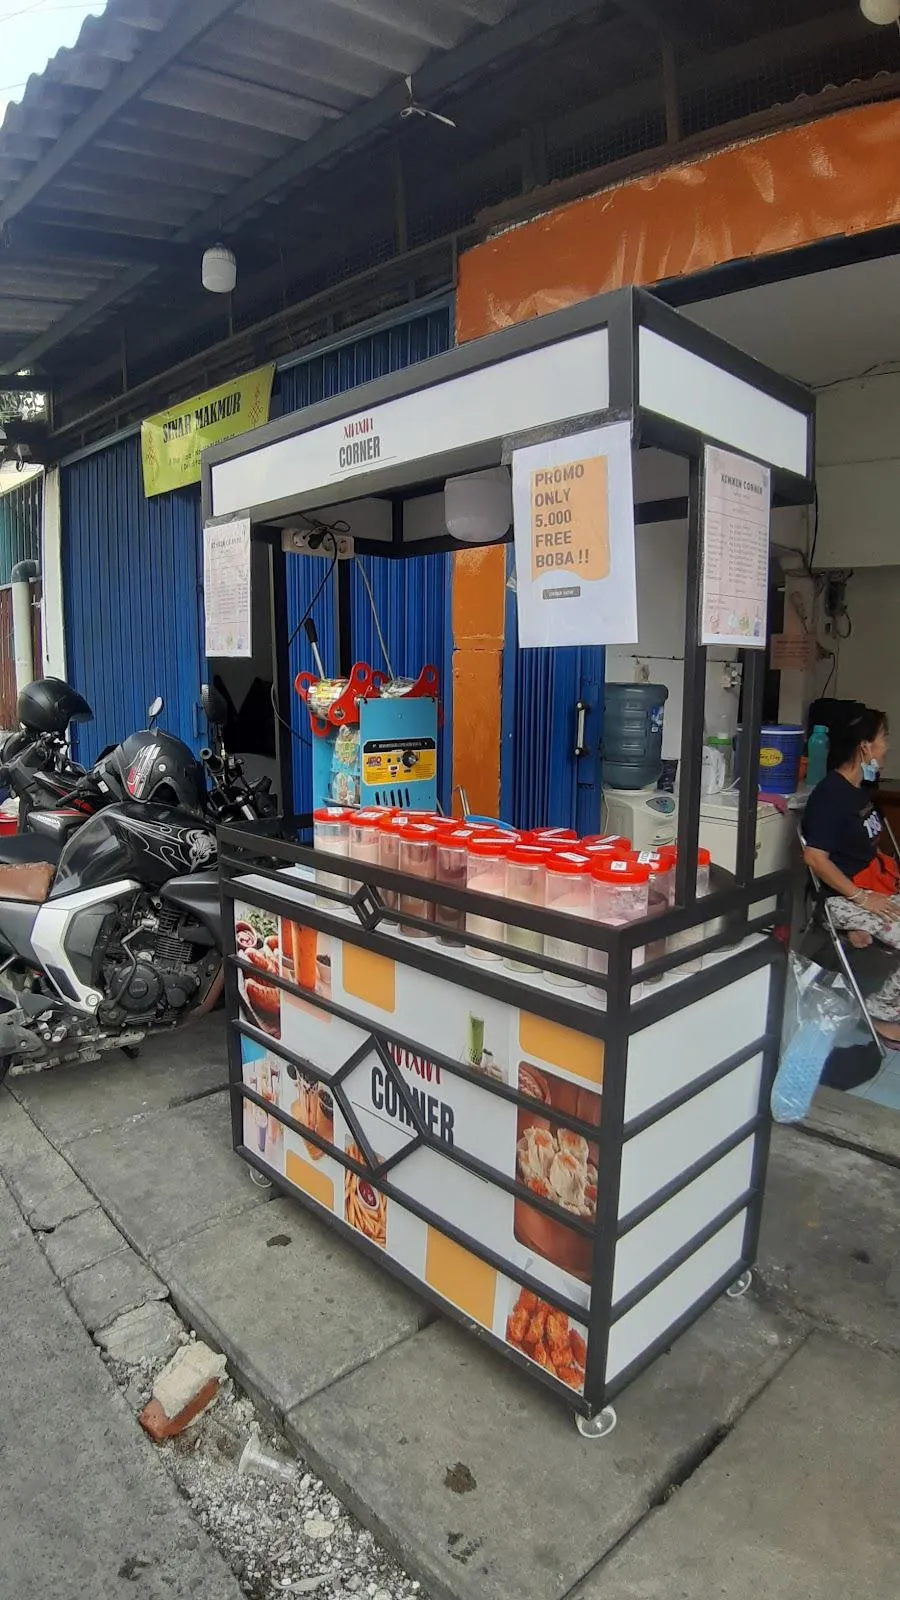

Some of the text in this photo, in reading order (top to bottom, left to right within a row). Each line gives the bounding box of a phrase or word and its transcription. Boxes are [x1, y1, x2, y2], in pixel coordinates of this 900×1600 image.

[162, 413, 192, 443] SINAR
[195, 391, 242, 430] MAKMUR
[339, 435, 381, 468] CORNER
[534, 464, 585, 487] PROMO
[534, 488, 572, 507] ONLY
[535, 509, 572, 528] 5.000
[535, 530, 573, 548] FREE
[535, 551, 575, 568] BOBA
